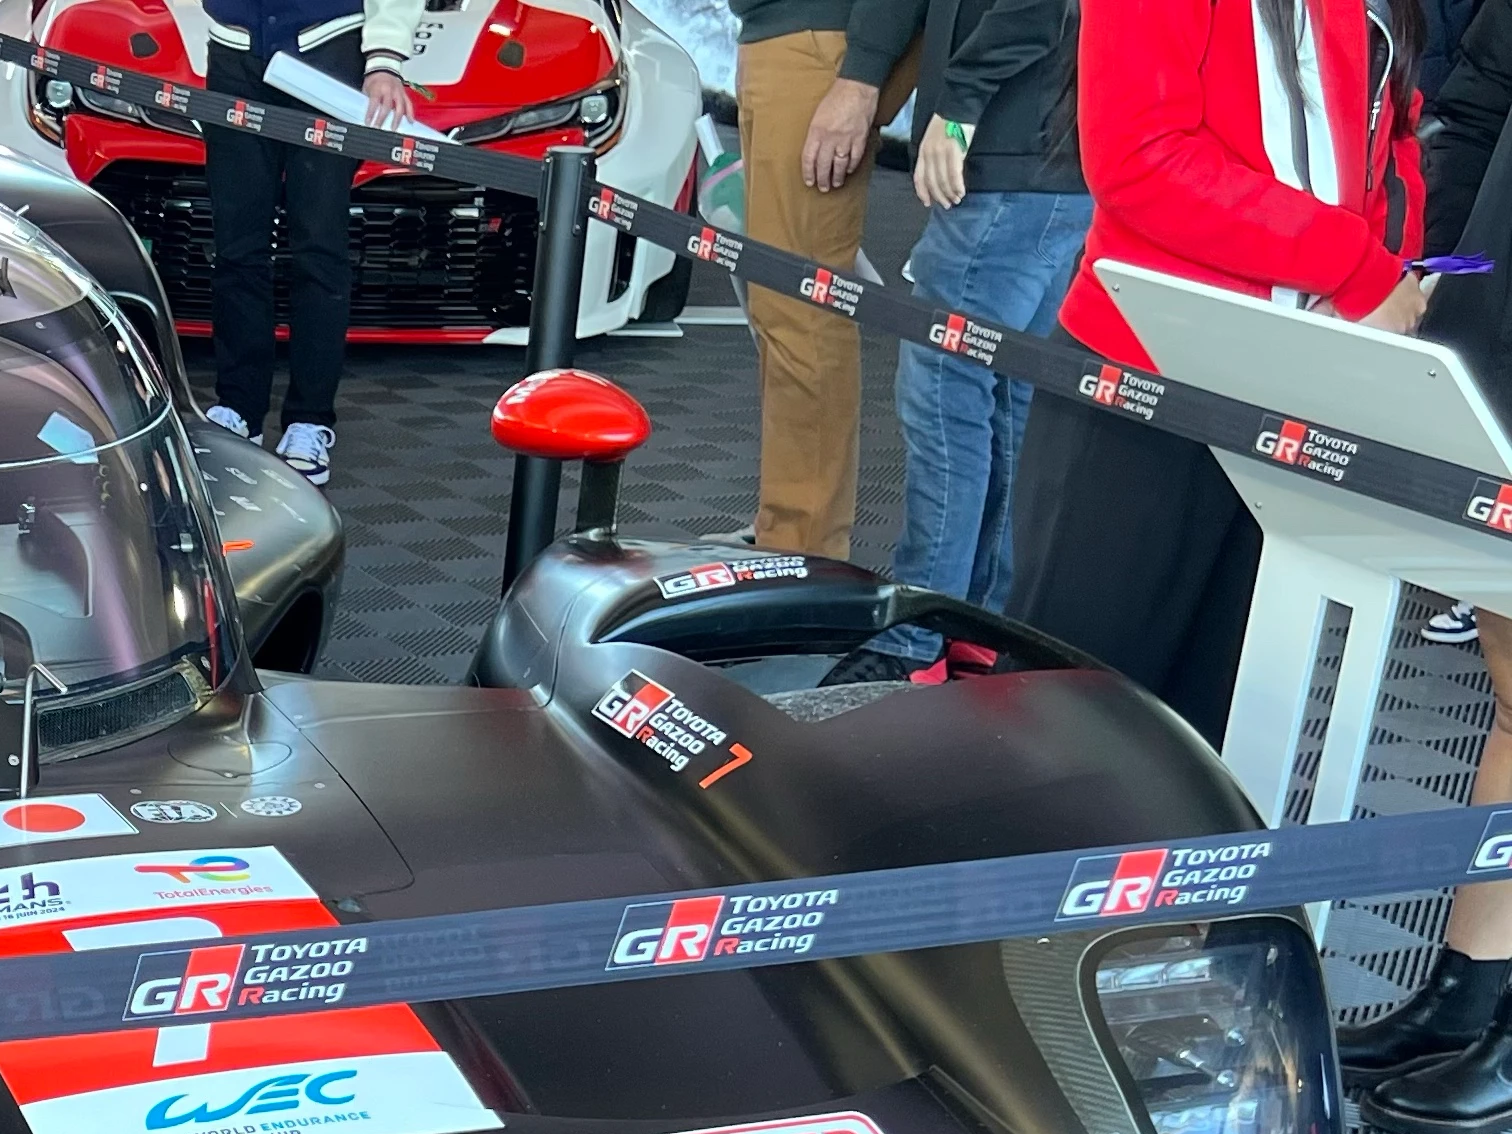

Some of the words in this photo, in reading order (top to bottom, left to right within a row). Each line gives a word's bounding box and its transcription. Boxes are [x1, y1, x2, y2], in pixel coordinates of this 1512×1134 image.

[391, 147, 412, 165] GR
[589, 196, 611, 219] GR
[687, 235, 713, 260] GR
[800, 277, 829, 304] GR
[929, 323, 960, 352] GR
[962, 332, 997, 352] GAZOO
[966, 321, 1003, 343] TOYOTA
[959, 343, 994, 366] Racing
[1079, 375, 1117, 404] GR
[1118, 384, 1158, 406] GAZOO
[1122, 371, 1165, 395] TOYOTA
[1114, 395, 1155, 420] Racing
[1255, 430, 1300, 465] GR
[1307, 428, 1358, 455] TOYOTA
[1302, 442, 1350, 467] GAZOO
[1297, 455, 1345, 481] Racing
[1466, 495, 1512, 529] GR
[664, 570, 729, 595] GR
[737, 567, 809, 581] Racing
[598, 688, 650, 730] GR
[665, 698, 727, 745] TOYOTA
[649, 713, 705, 755] GAZOO
[636, 726, 690, 772] Racing
[698, 743, 753, 789] 7
[1172, 842, 1271, 867] TOYOTA
[1474, 832, 1512, 868] G
[1162, 864, 1257, 887] GAZOO
[153, 885, 273, 900] TotalEnergies
[730, 889, 838, 914] TOYOTA
[1062, 876, 1153, 915] GR
[1155, 885, 1249, 908] Racing
[721, 912, 824, 936] GAZOO
[251, 938, 368, 963] TOYOTA
[613, 924, 710, 964] GR
[714, 933, 816, 956] Racing
[244, 960, 353, 984] GAZOO
[130, 973, 231, 1014] GR
[238, 982, 345, 1006] Racing
[145, 1069, 358, 1130] WEC
[260, 1111, 371, 1132] ENDURANCE
